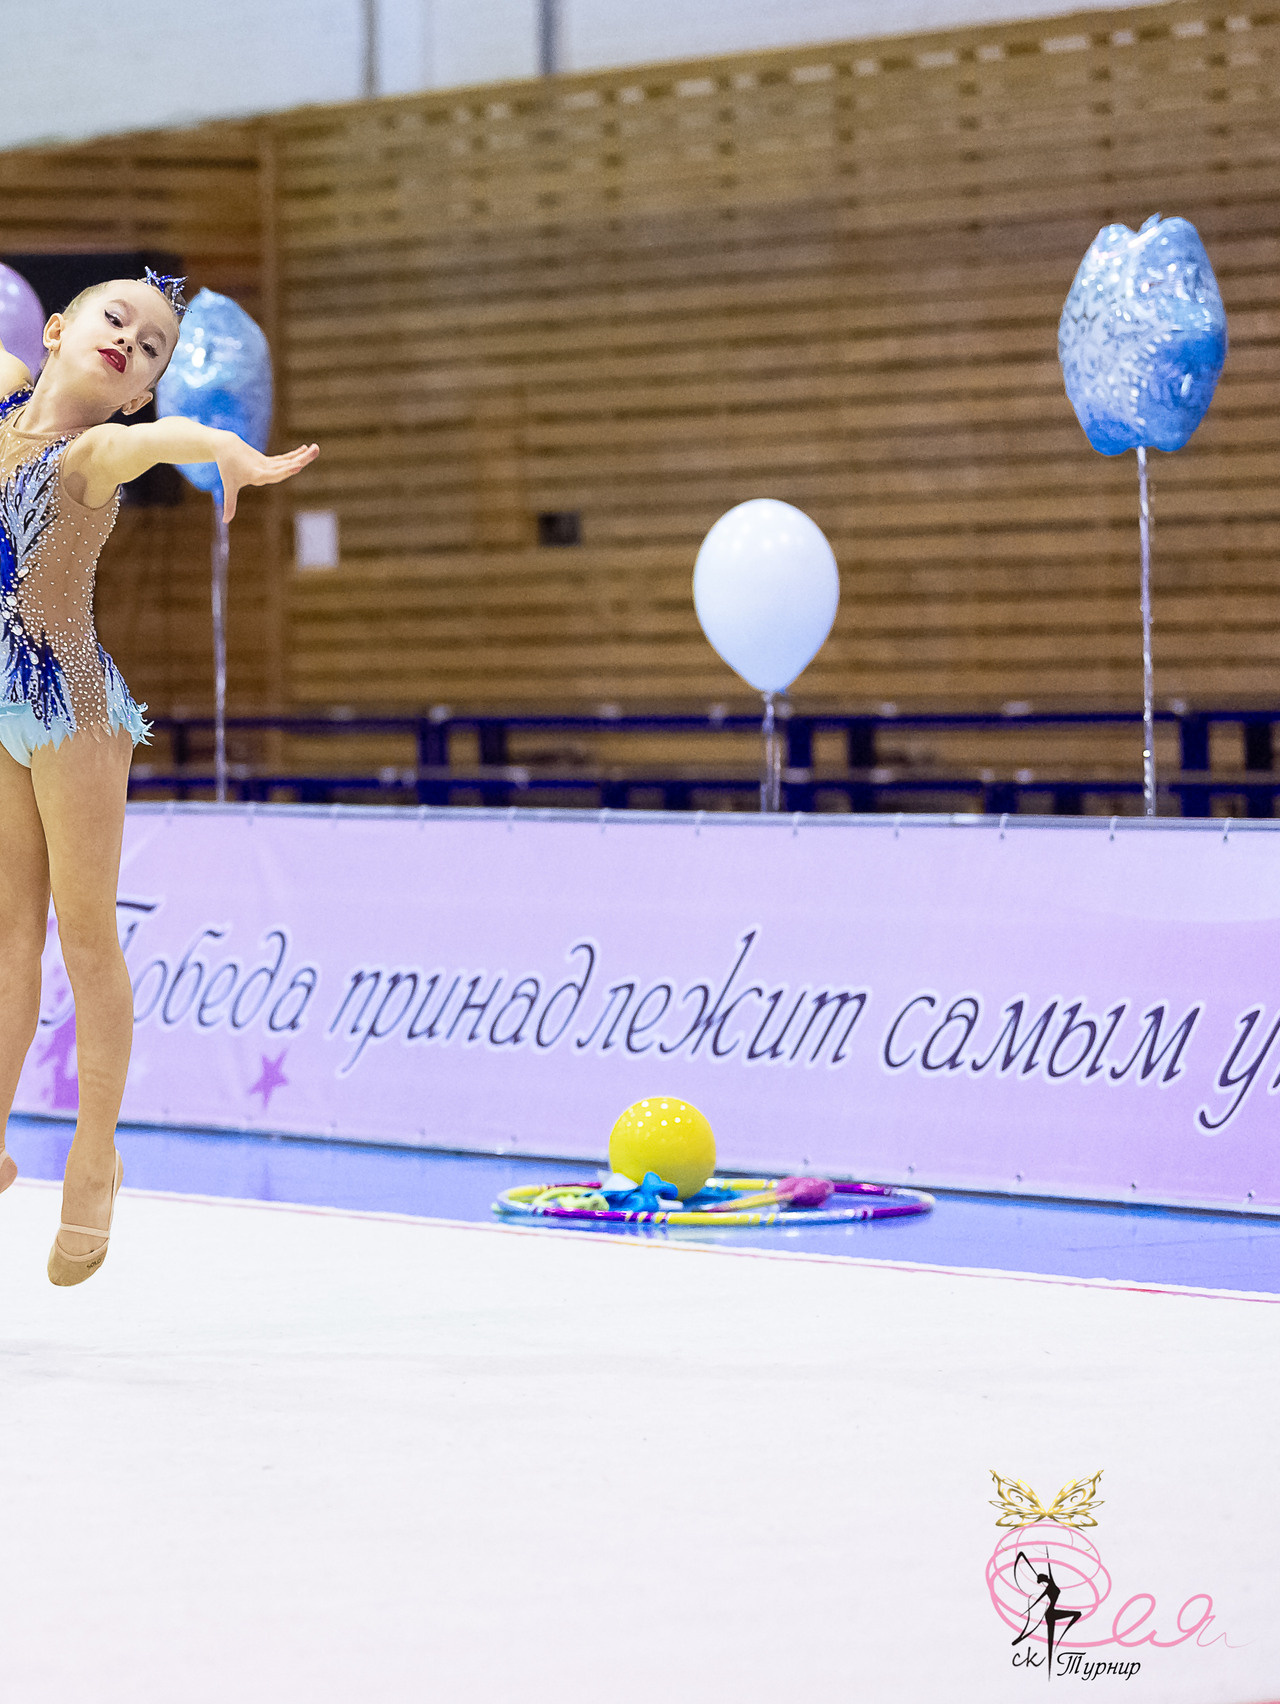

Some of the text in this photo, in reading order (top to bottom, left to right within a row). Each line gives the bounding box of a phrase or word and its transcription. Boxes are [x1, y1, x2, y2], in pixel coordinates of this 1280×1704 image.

[328, 929, 867, 1074] принадлежит
[883, 995, 1202, 1083] самым
[1198, 1008, 1280, 1130] у
